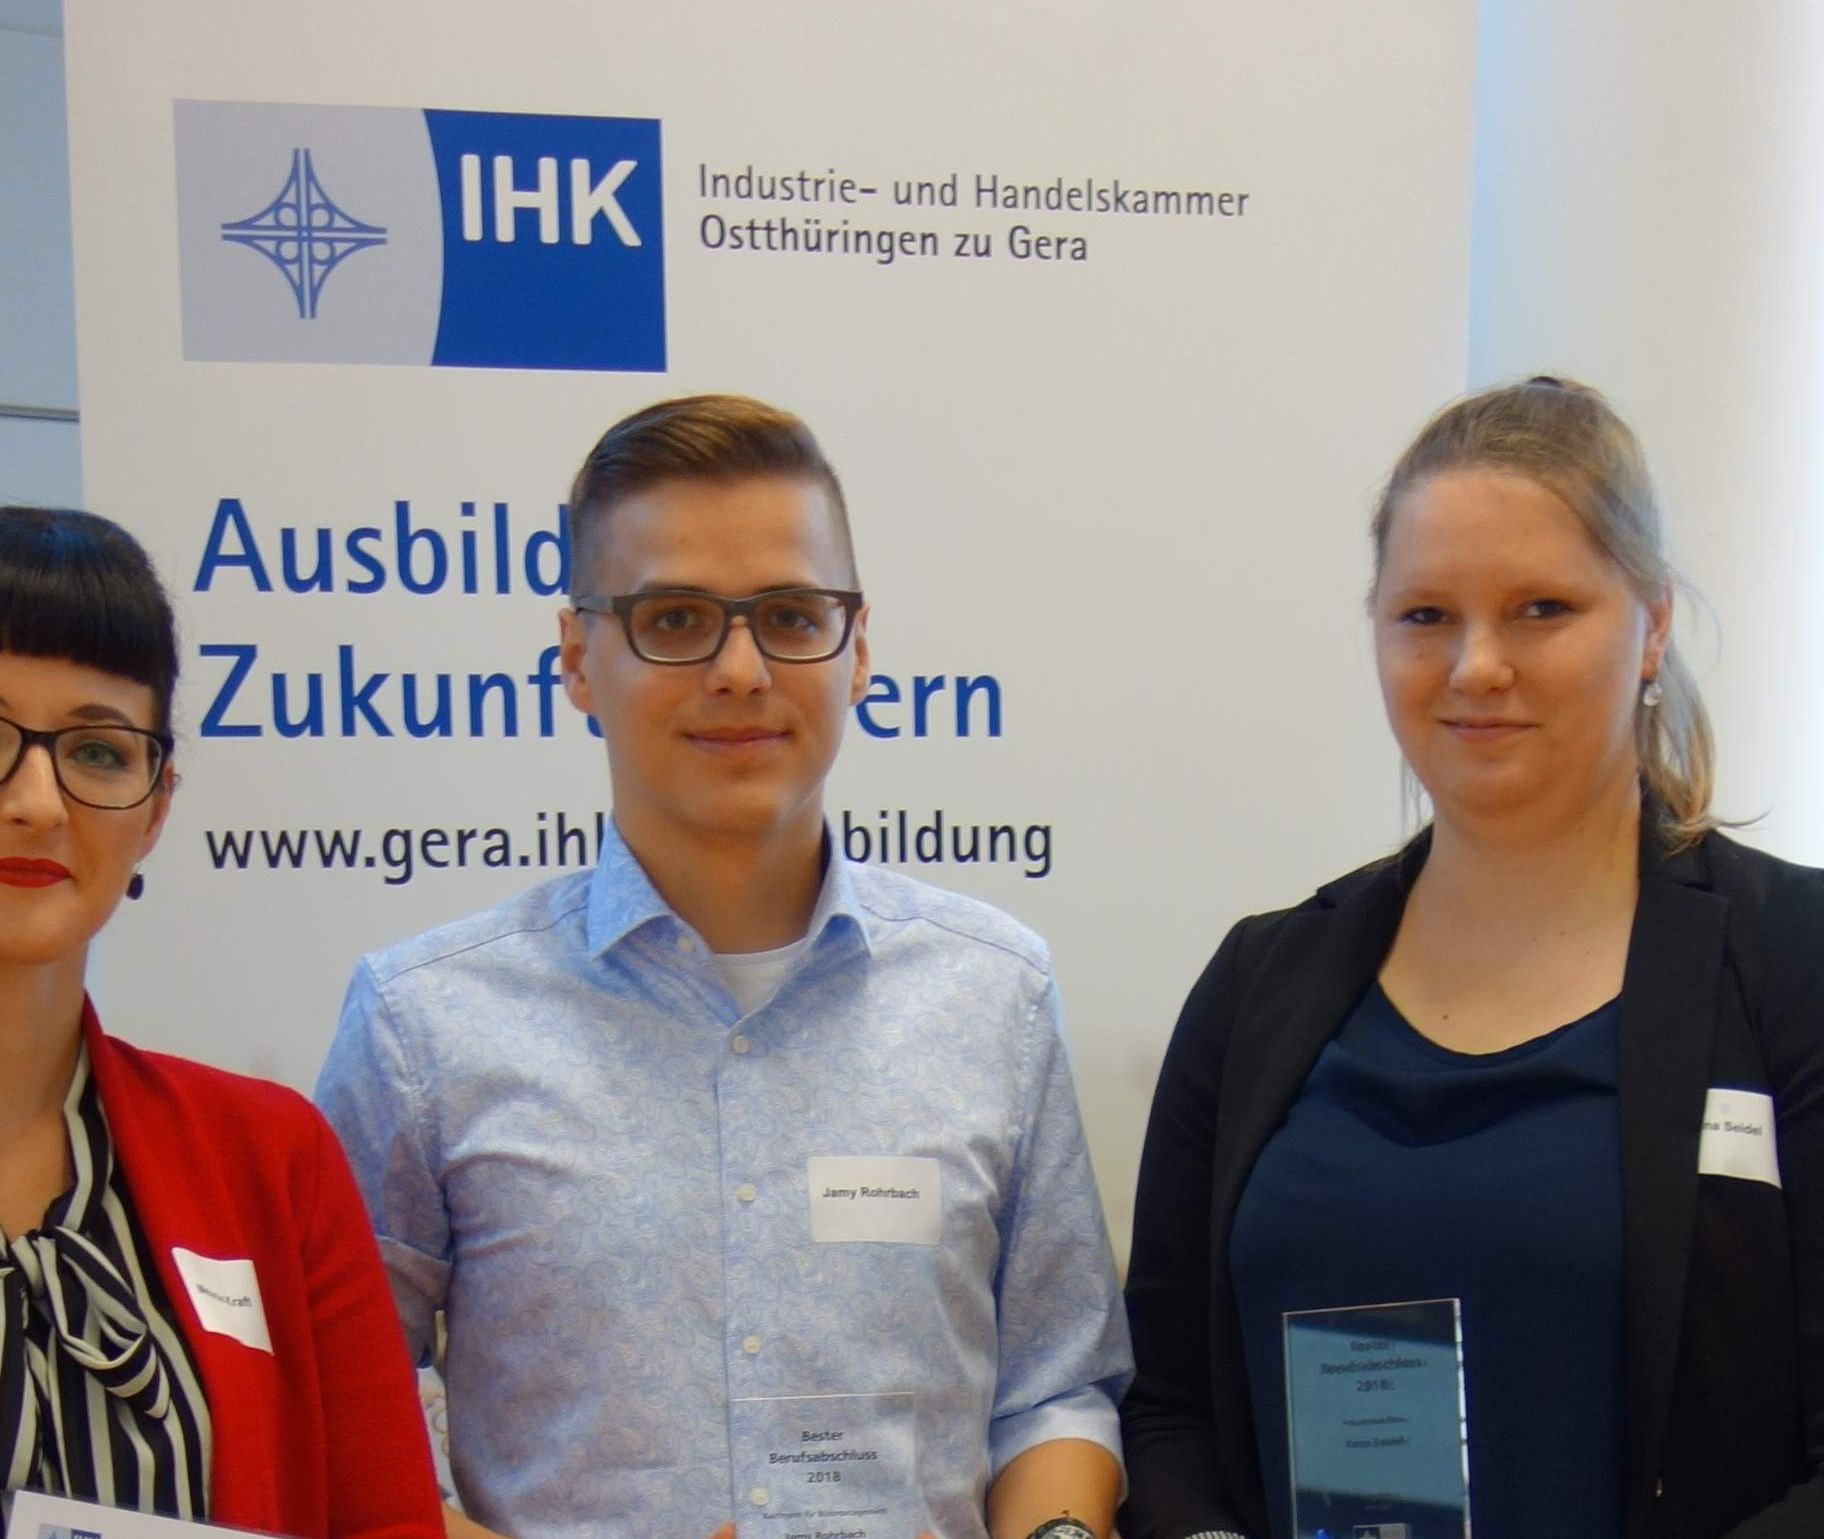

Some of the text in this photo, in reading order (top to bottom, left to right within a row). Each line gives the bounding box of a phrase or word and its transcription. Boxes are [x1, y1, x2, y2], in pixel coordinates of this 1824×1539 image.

[460, 153, 643, 248] IHK
[698, 163, 1251, 218] Industrie- und Handelskammer
[698, 214, 1089, 265] Ostthüringen zu Gera
[192, 497, 573, 597] Ausbild
[198, 643, 607, 740] Zukunf
[859, 1186, 921, 1200] Rohrbach
[768, 1449, 879, 1464] Berufsabschluss
[800, 1430, 845, 1442] Bester
[807, 1470, 842, 1483] 2018
